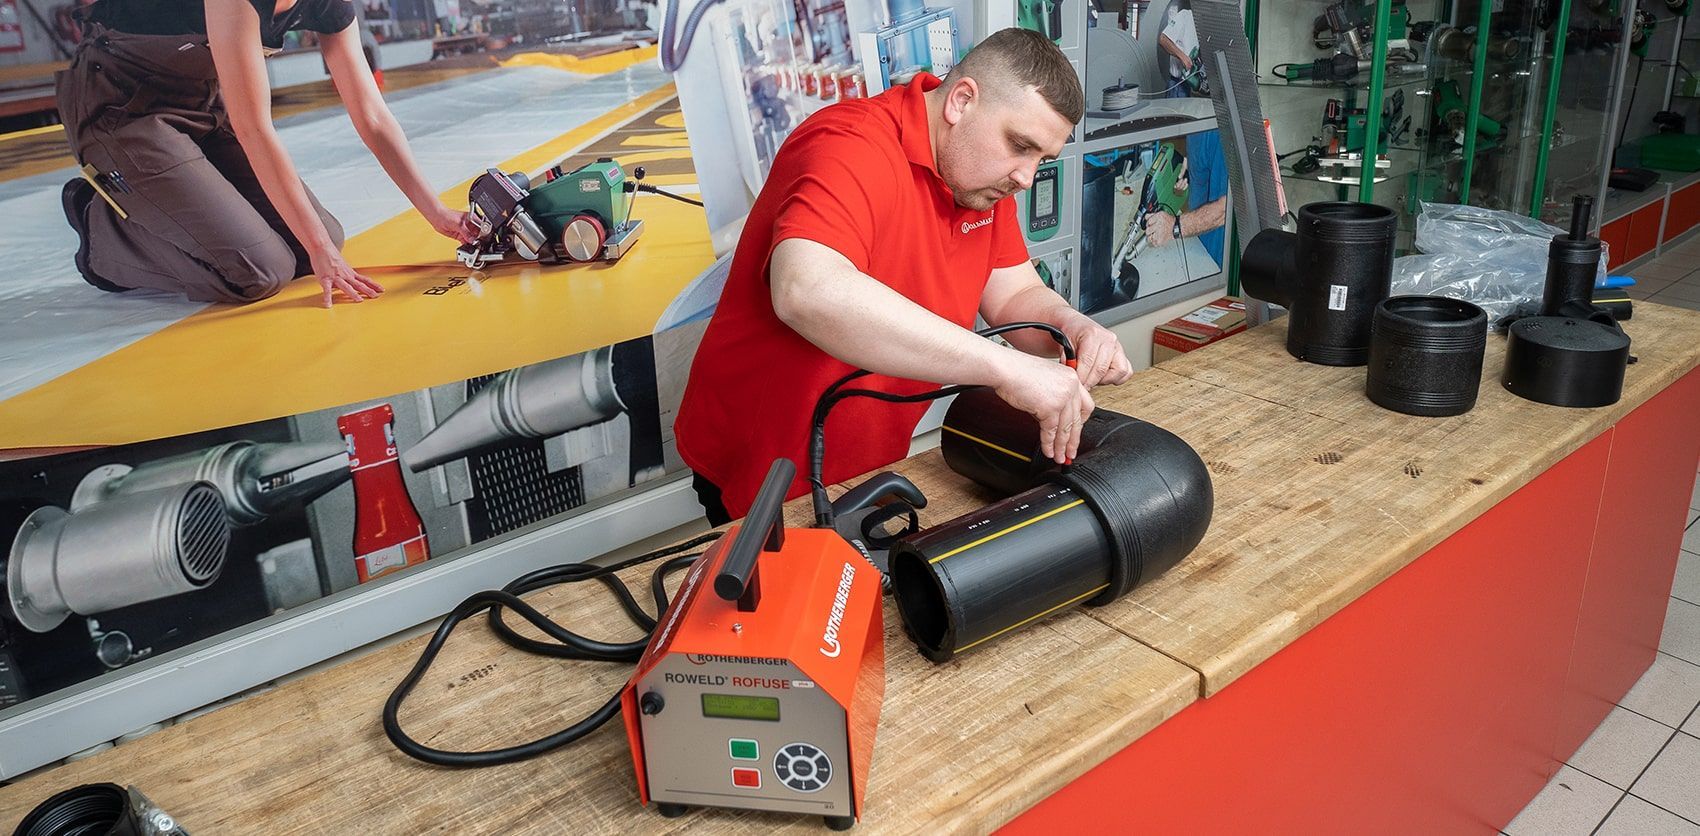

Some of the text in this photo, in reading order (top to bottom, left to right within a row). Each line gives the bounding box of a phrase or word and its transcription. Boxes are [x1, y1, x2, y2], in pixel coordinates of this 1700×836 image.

[820, 562, 856, 657] ROTHENBERGER
[697, 654, 788, 666] ROTHENBERGER
[732, 677, 790, 690] ROFUSE
